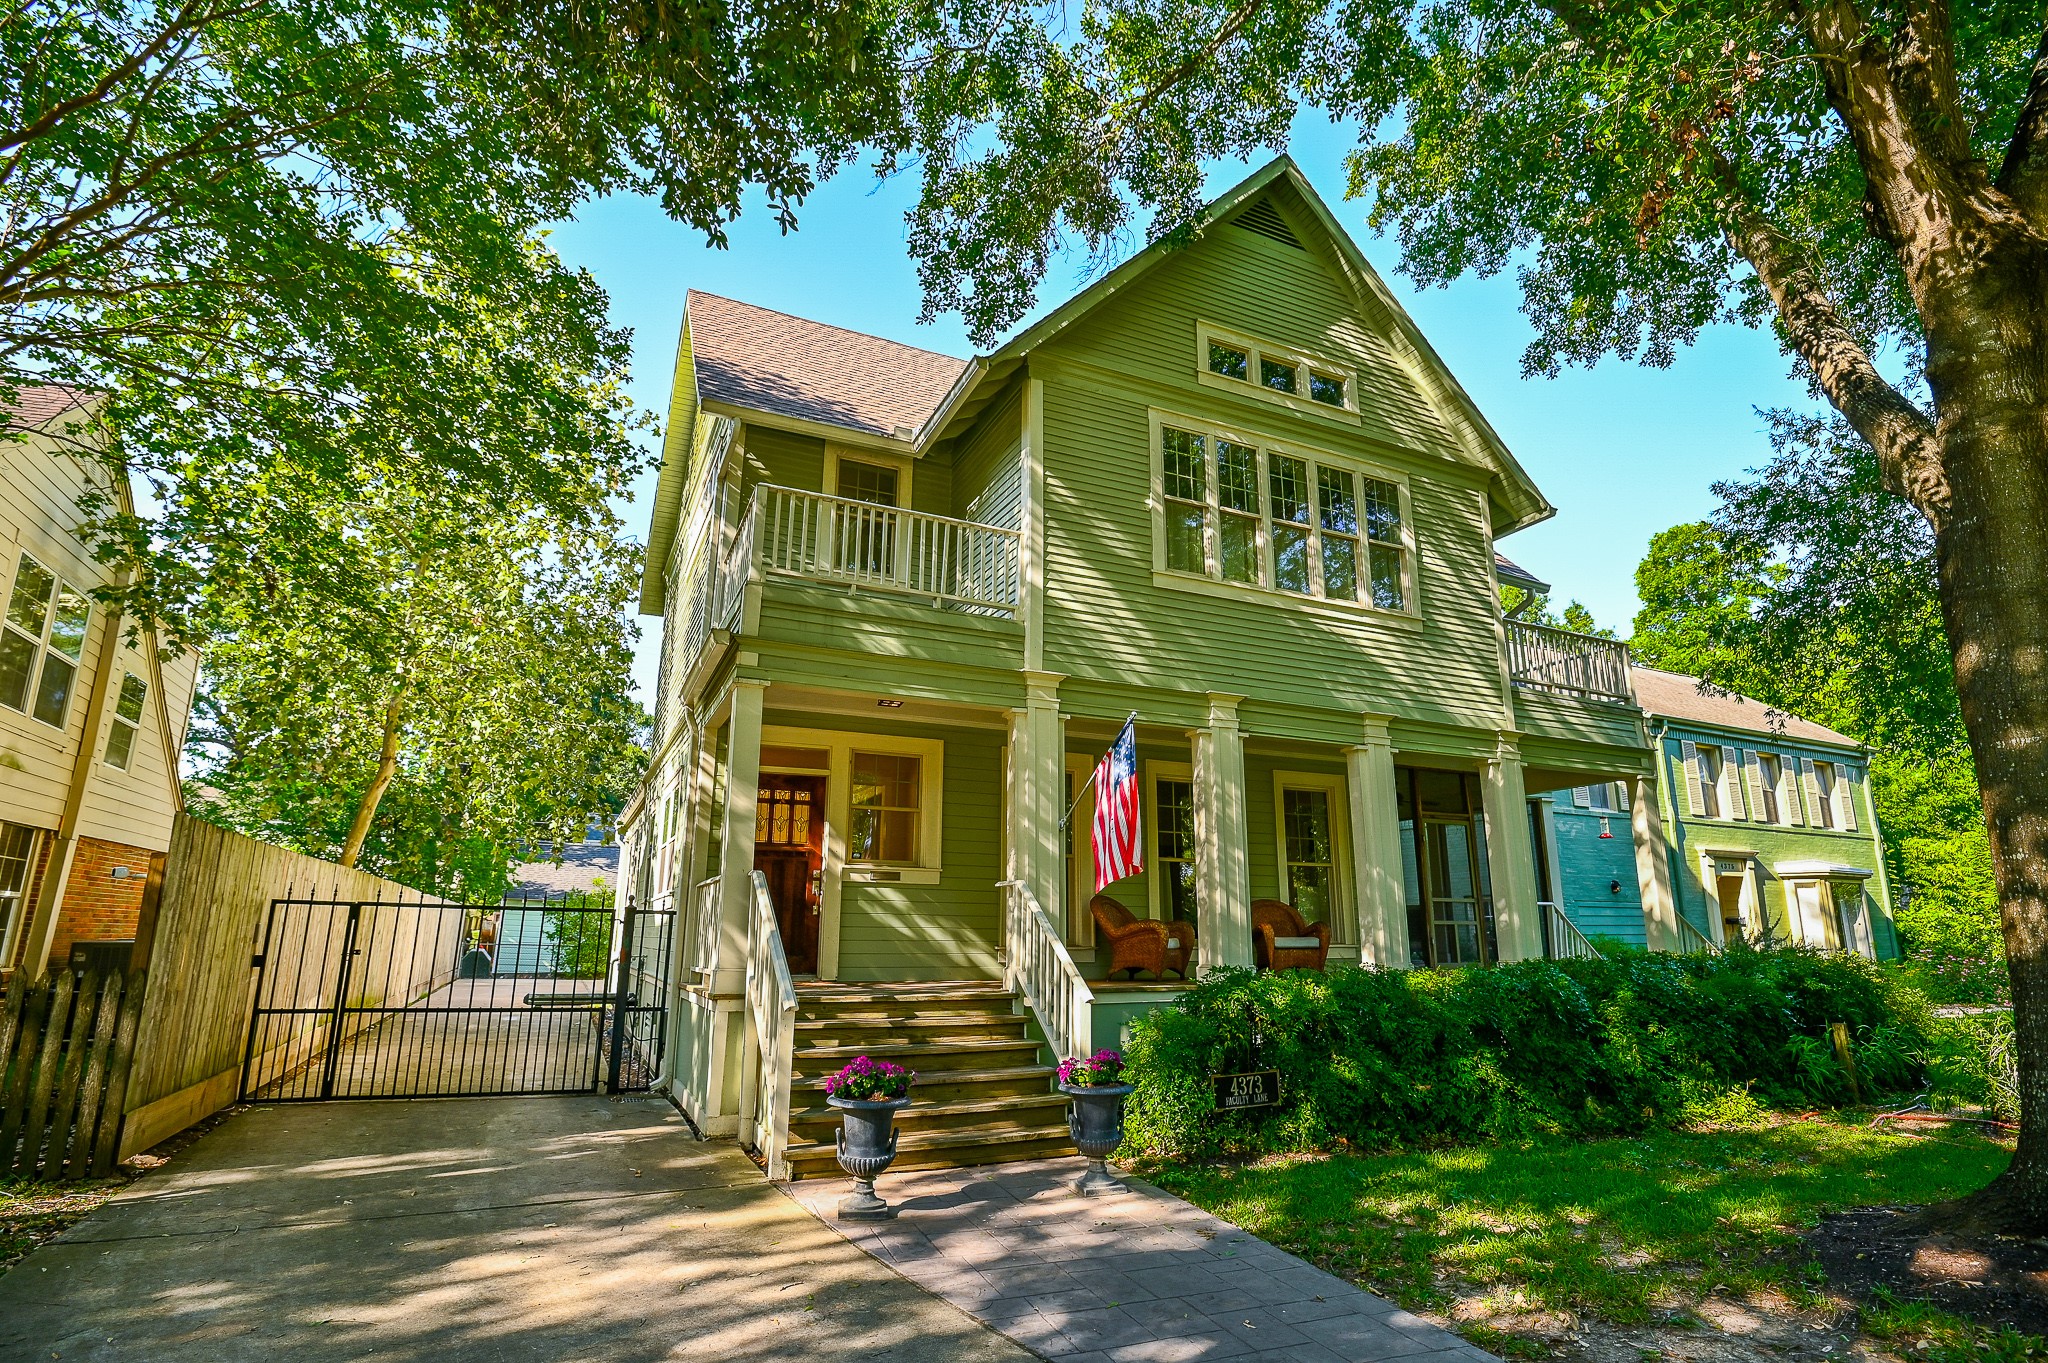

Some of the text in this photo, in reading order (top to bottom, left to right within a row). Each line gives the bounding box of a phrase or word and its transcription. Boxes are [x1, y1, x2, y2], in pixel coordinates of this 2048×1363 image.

[1230, 1075, 1263, 1096] 4373
[1225, 1092, 1269, 1106] FACULTY LANE
